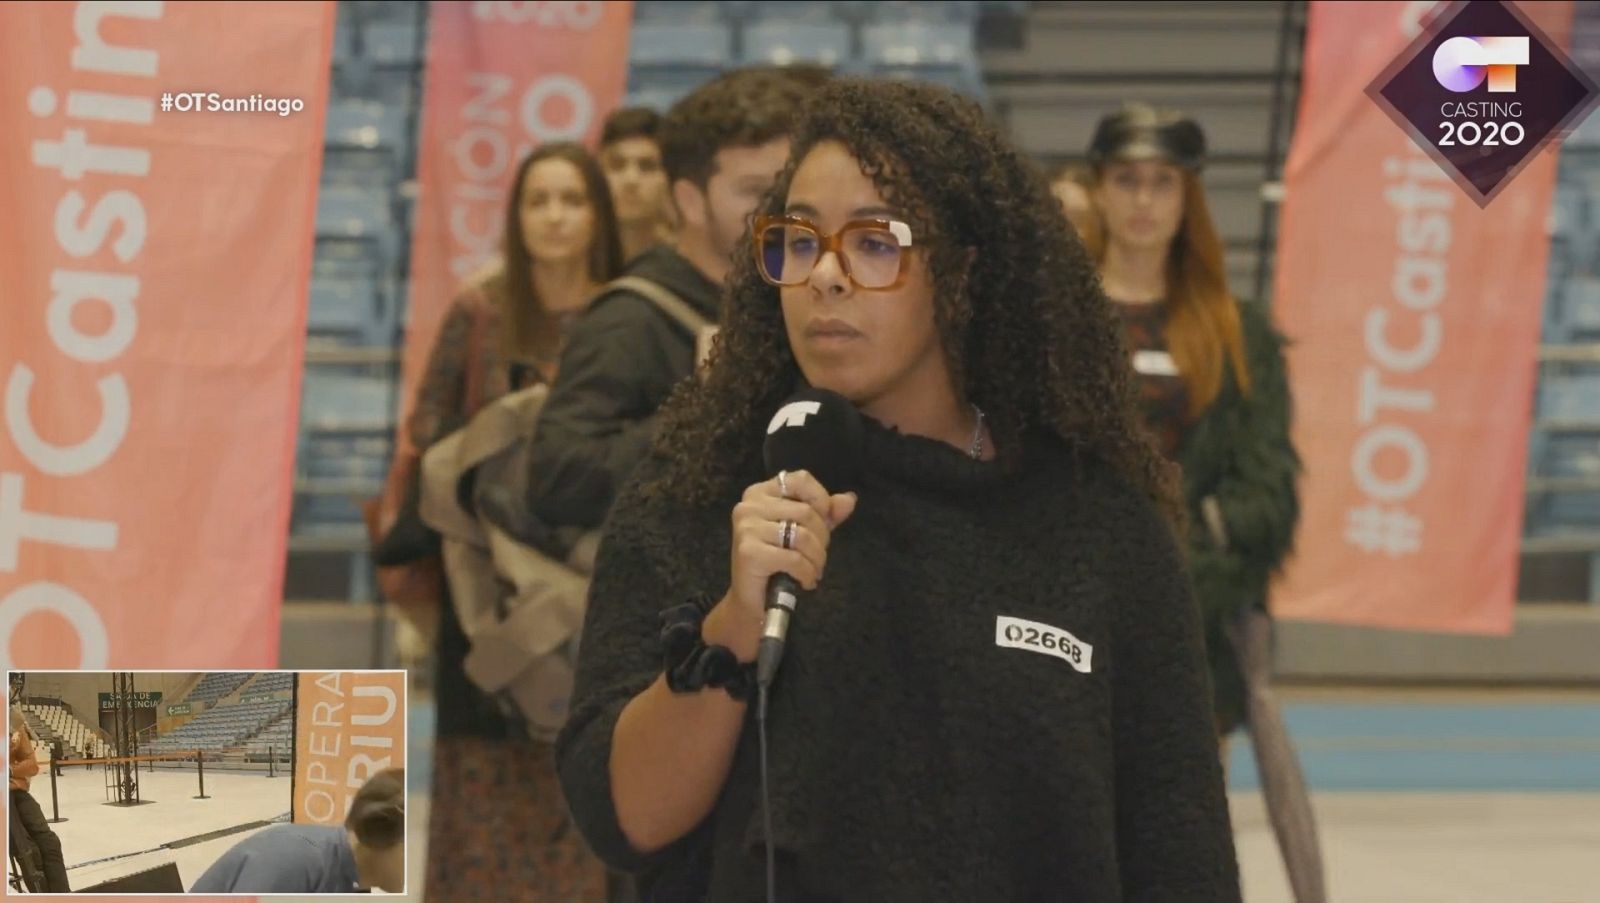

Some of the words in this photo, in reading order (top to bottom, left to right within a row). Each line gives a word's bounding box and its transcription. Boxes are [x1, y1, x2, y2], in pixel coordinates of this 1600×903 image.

[1344, 138, 1456, 557] #OTCasti
[1004, 623, 1082, 664] 02668
[304, 672, 345, 823] OPERA
[344, 685, 397, 816] RIU
